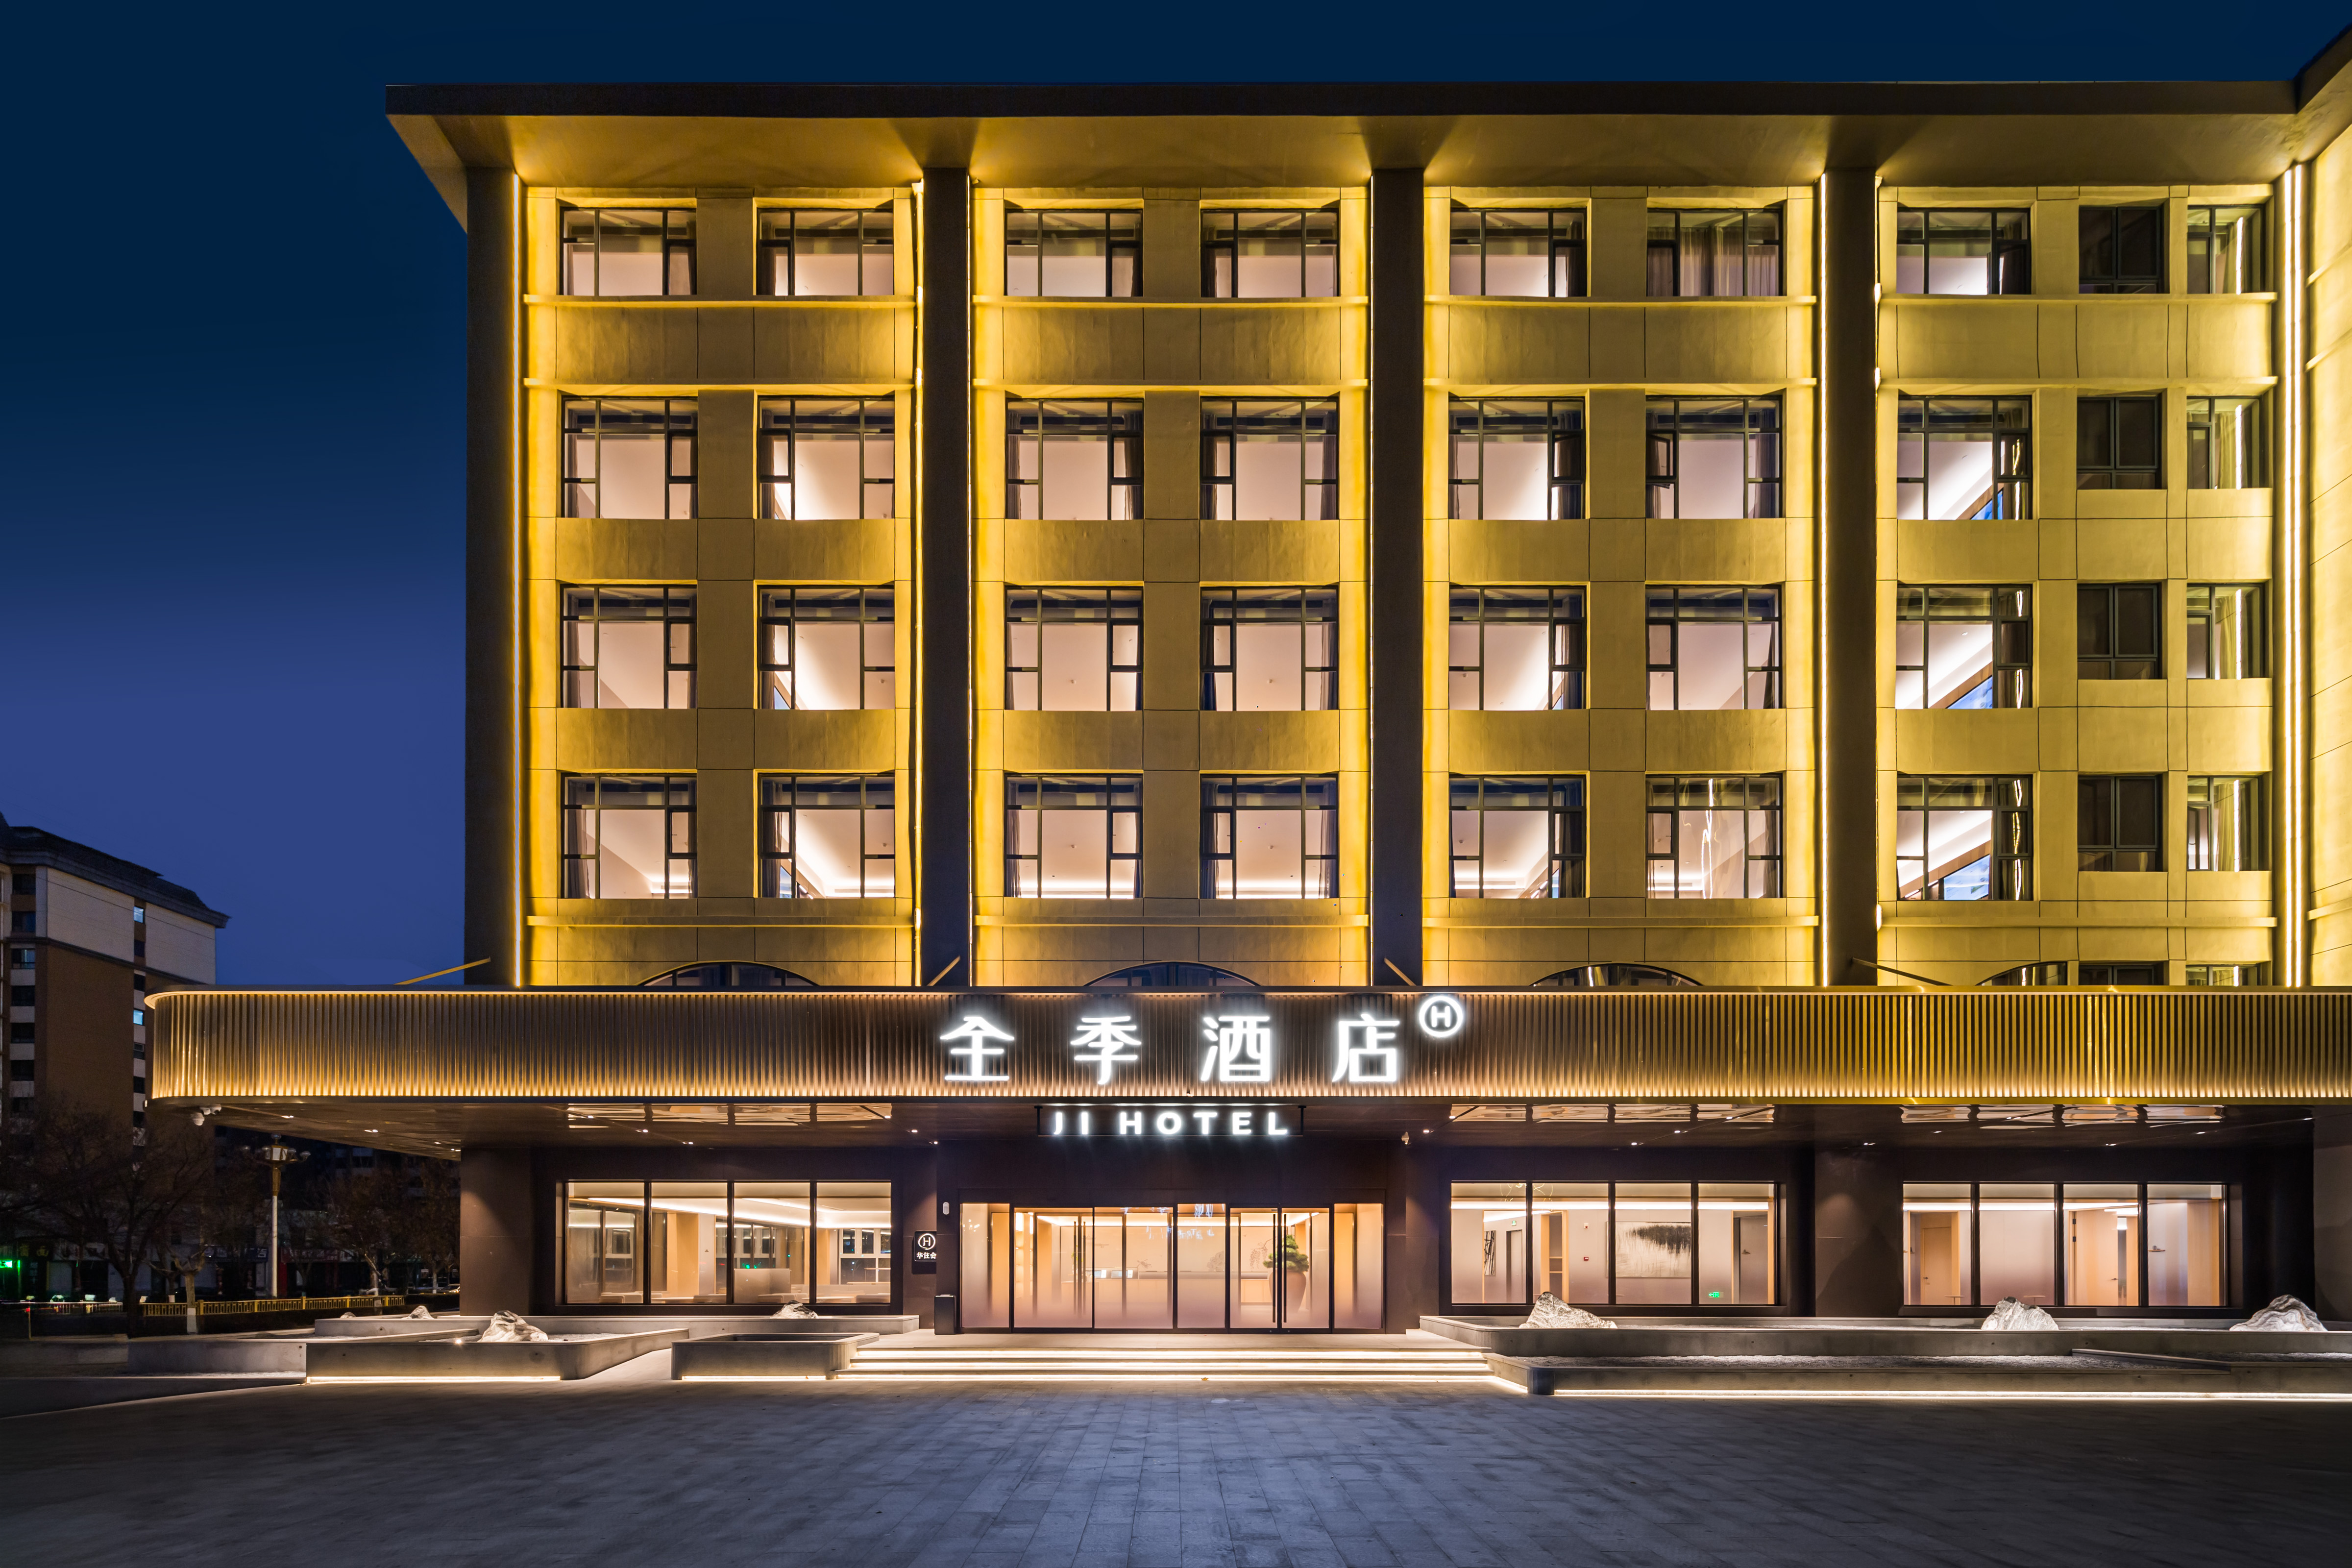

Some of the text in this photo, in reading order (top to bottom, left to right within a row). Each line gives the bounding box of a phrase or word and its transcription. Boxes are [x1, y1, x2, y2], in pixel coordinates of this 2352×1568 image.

[940, 1013, 1400, 1085] 全季酒店
[1054, 1112, 1287, 1135] JI HOTEL
